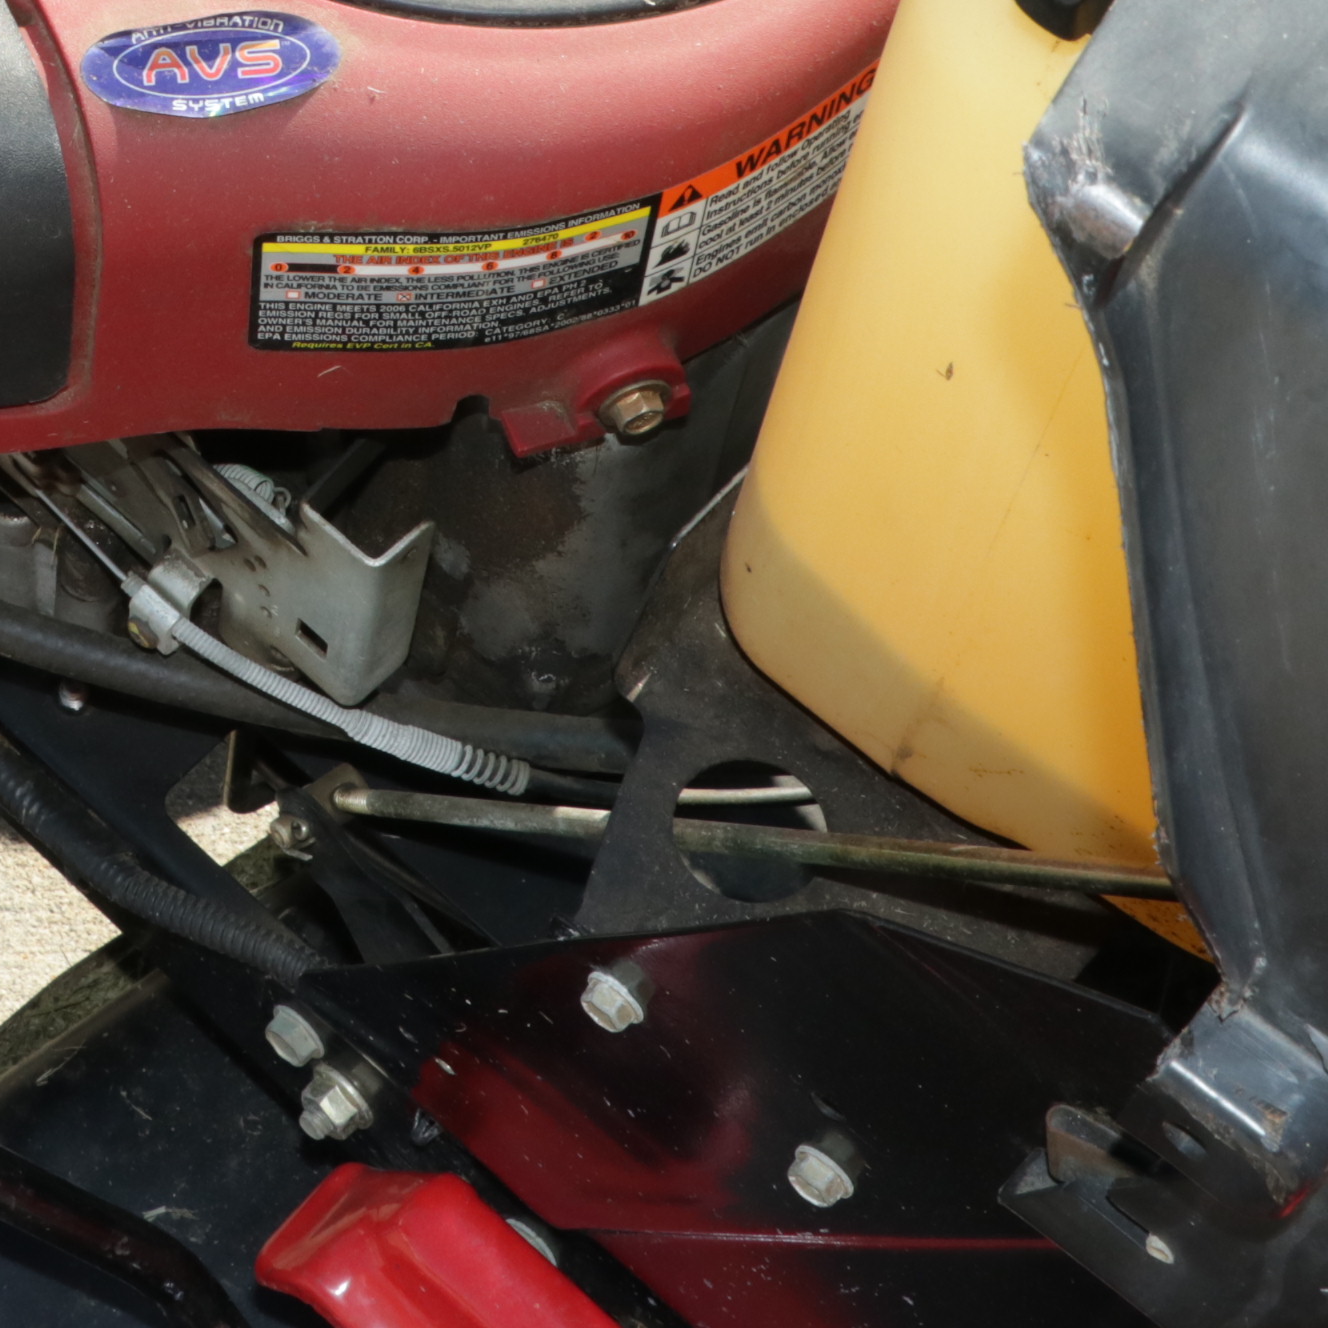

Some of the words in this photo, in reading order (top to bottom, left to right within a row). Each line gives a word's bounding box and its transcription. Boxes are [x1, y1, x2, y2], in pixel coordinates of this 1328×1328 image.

[131, 15, 285, 45] ANTI-VIBRATION
[142, 39, 284, 87] AVS
[172, 92, 266, 112] SYSTEM
[735, 67, 877, 180] WARNING
[706, 176, 774, 221] Instructions
[777, 152, 810, 179] before
[812, 120, 852, 153] running
[710, 183, 740, 207] Read
[742, 169, 764, 190] and
[767, 150, 799, 174] follow
[801, 109, 851, 151] Operating
[698, 229, 724, 249] cool
[725, 222, 737, 235] at
[739, 205, 764, 228] least
[765, 199, 773, 212] 2
[774, 172, 814, 205] minutes
[816, 149, 847, 176] before
[702, 204, 750, 236] Gasoline
[752, 196, 762, 208] is
[276, 235, 321, 243] BRIGGS
[323, 235, 331, 243] &
[332, 235, 394, 244] STRATTON
[395, 235, 431, 244] CORP.
[439, 231, 506, 244] IMPORTANT
[506, 221, 566, 239] EMISSIONS
[568, 202, 641, 228] INFORMATION
[692, 261, 713, 278] DO
[715, 243, 743, 266] NOT
[744, 232, 764, 250] run
[766, 224, 776, 235] in
[779, 184, 830, 228] enclosed
[695, 235, 743, 266] Engines
[744, 217, 769, 239] emit
[771, 193, 807, 222] carbon
[264, 274, 284, 282] THE
[286, 274, 325, 283] LOWER
[327, 276, 347, 284] THE
[349, 276, 367, 284] AIR
[405, 276, 426, 284] THE
[427, 275, 454, 284] LESS
[518, 265, 540, 275] THIS
[543, 255, 579, 271] ENGINE
[581, 252, 591, 261] IS
[593, 239, 641, 258] CERTIFIED
[333, 254, 363, 264] THE
[367, 255, 393, 265] AIR
[396, 255, 440, 265] INDEX
[443, 254, 466, 264] OF
[467, 252, 500, 262] THIS
[503, 242, 557, 259] ENGINE
[560, 237, 574, 248] IS
[365, 246, 411, 254] FAMILY:
[276, 283, 338, 291] CALIFORNIA
[357, 284, 371, 292] BE
[373, 284, 429, 292] EMISSIONS
[431, 281, 493, 292] COMPLIANT
[493, 278, 516, 288] FOR
[516, 273, 538, 283] THE
[538, 259, 598, 281] FOLLOWING
[304, 292, 383, 301] MODERATE
[415, 286, 516, 302] INTERMEDIATE
[549, 260, 619, 284] EXTENDED
[258, 310, 316, 318] EMISSION
[318, 311, 352, 319] REGS
[382, 312, 423, 320] SMALL
[425, 309, 487, 320] OFF-ROAD
[548, 287, 587, 302] REFER
[588, 282, 604, 292] TO
[289, 303, 333, 311] ENGINE
[337, 304, 377, 313] MEETS
[379, 305, 406, 313] 2006
[409, 301, 481, 312] CALIFORNIA
[483, 296, 507, 308] EXH
[510, 293, 534, 304] AND
[537, 286, 560, 298] EPA
[562, 282, 578, 292] PH
[580, 280, 587, 288] 2
[258, 317, 313, 325] OWNER'S
[316, 318, 366, 327] MANUAL
[397, 315, 482, 327] MAINTENANCE
[284, 333, 348, 341] EMISSIONS
[351, 334, 429, 343] COMPLIANCE
[431, 331, 479, 341] PERIOD:
[556, 313, 565, 321] C
[286, 325, 343, 334] EMISSION
[345, 326, 416, 335] DURABILITY
